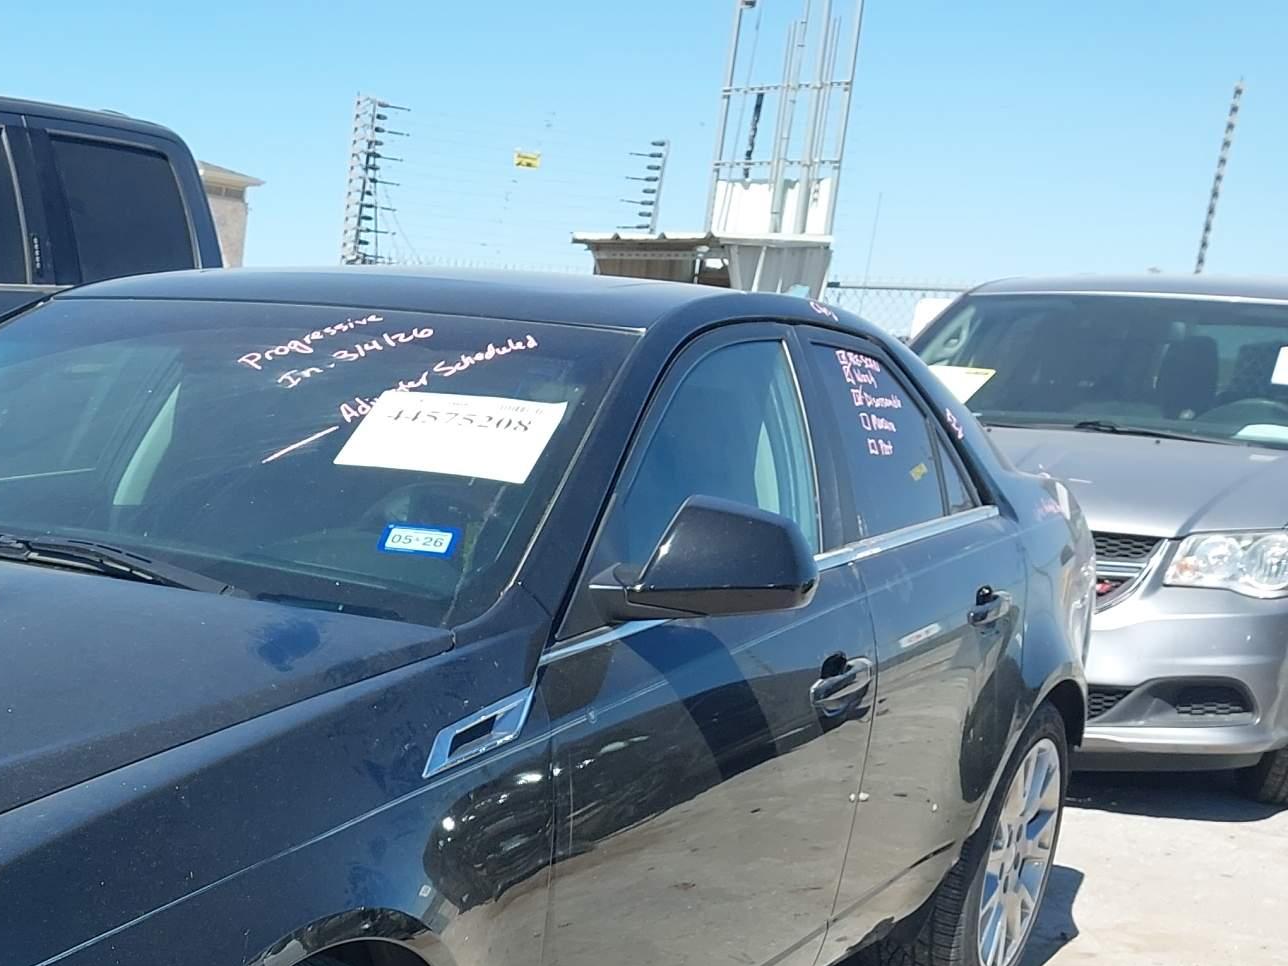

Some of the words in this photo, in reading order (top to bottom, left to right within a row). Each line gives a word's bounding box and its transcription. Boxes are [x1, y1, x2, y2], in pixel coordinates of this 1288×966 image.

[237, 313, 384, 370] Progressive
[432, 334, 539, 377] Scheduled
[387, 408, 532, 433] 44575208
[422, 536, 445, 548] 26
